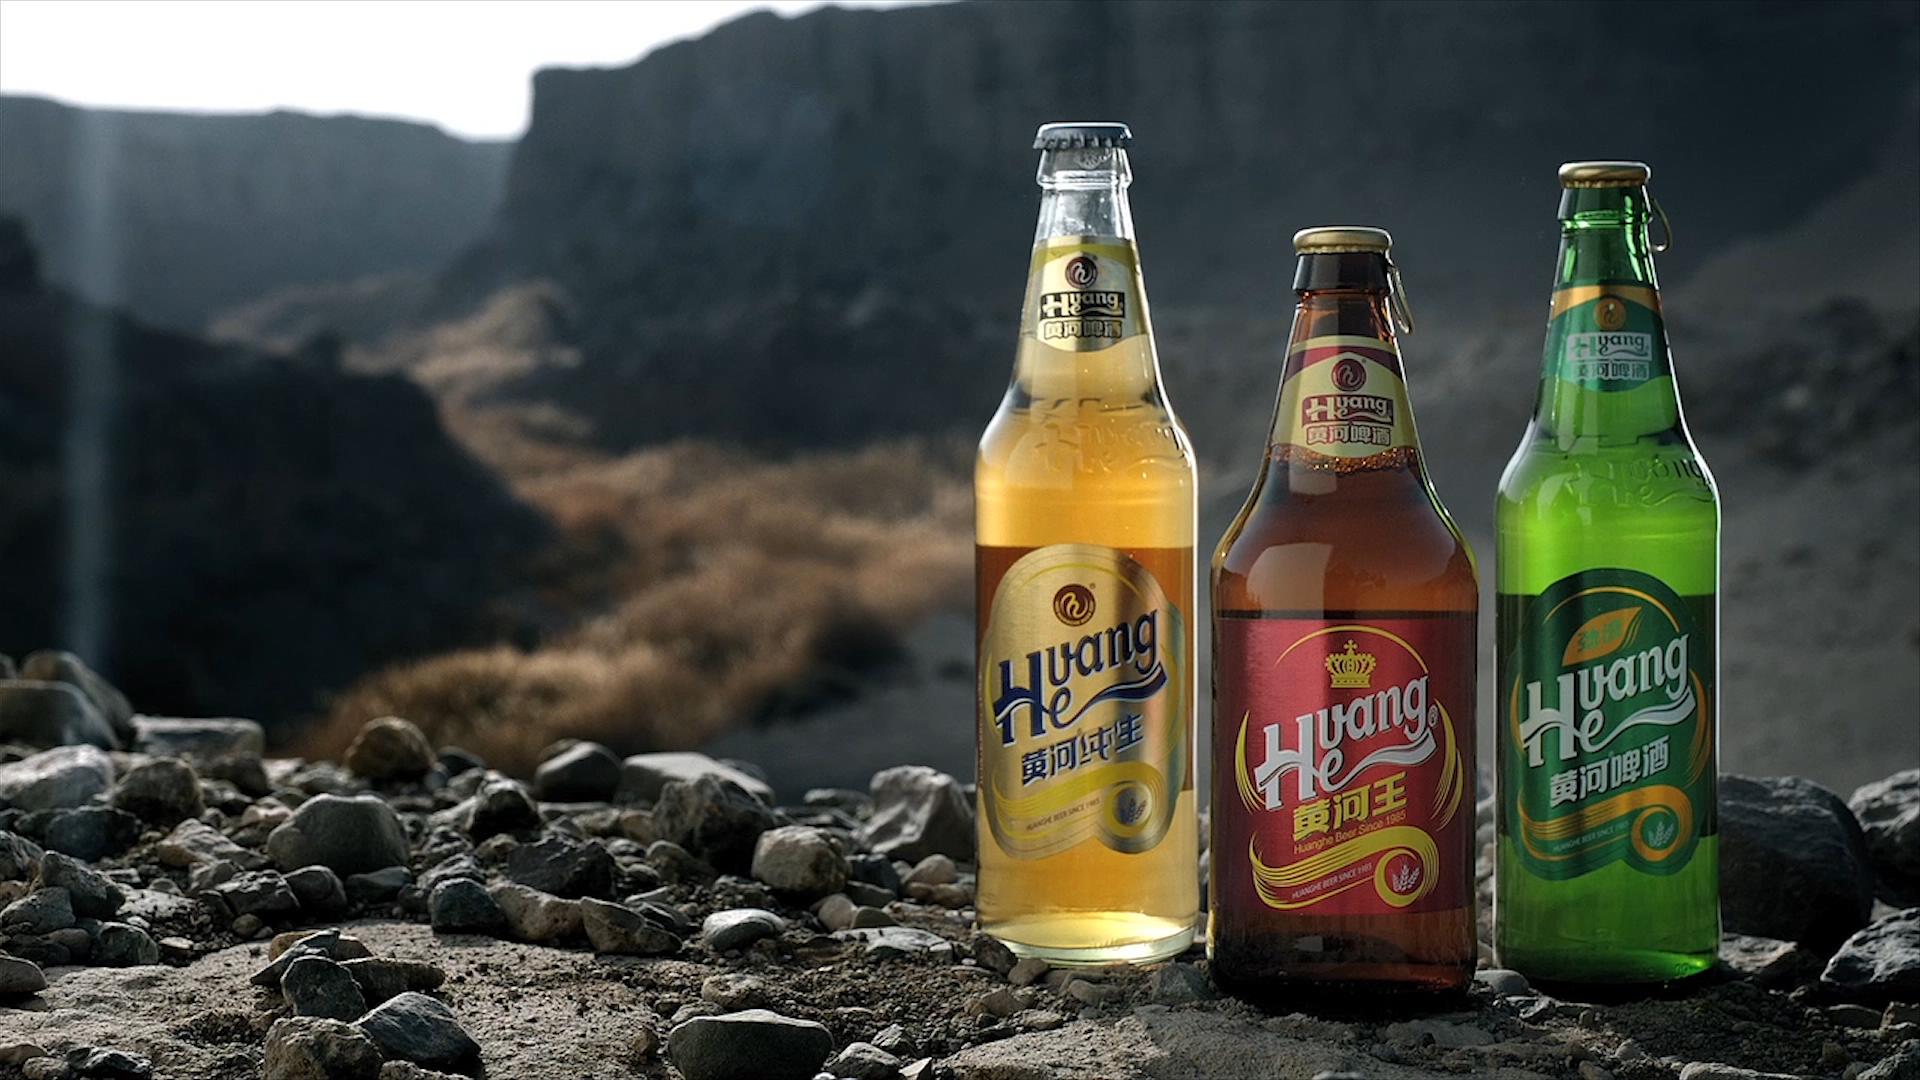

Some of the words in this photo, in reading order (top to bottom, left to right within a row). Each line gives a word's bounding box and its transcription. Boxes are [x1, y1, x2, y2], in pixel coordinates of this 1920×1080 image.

[1293, 771, 1408, 842] 黄河王
[1550, 736, 1670, 809] 黄河啤酒
[1294, 836, 1334, 854] Huanghe
[1335, 829, 1357, 843] Beer
[1359, 819, 1384, 834] Since
